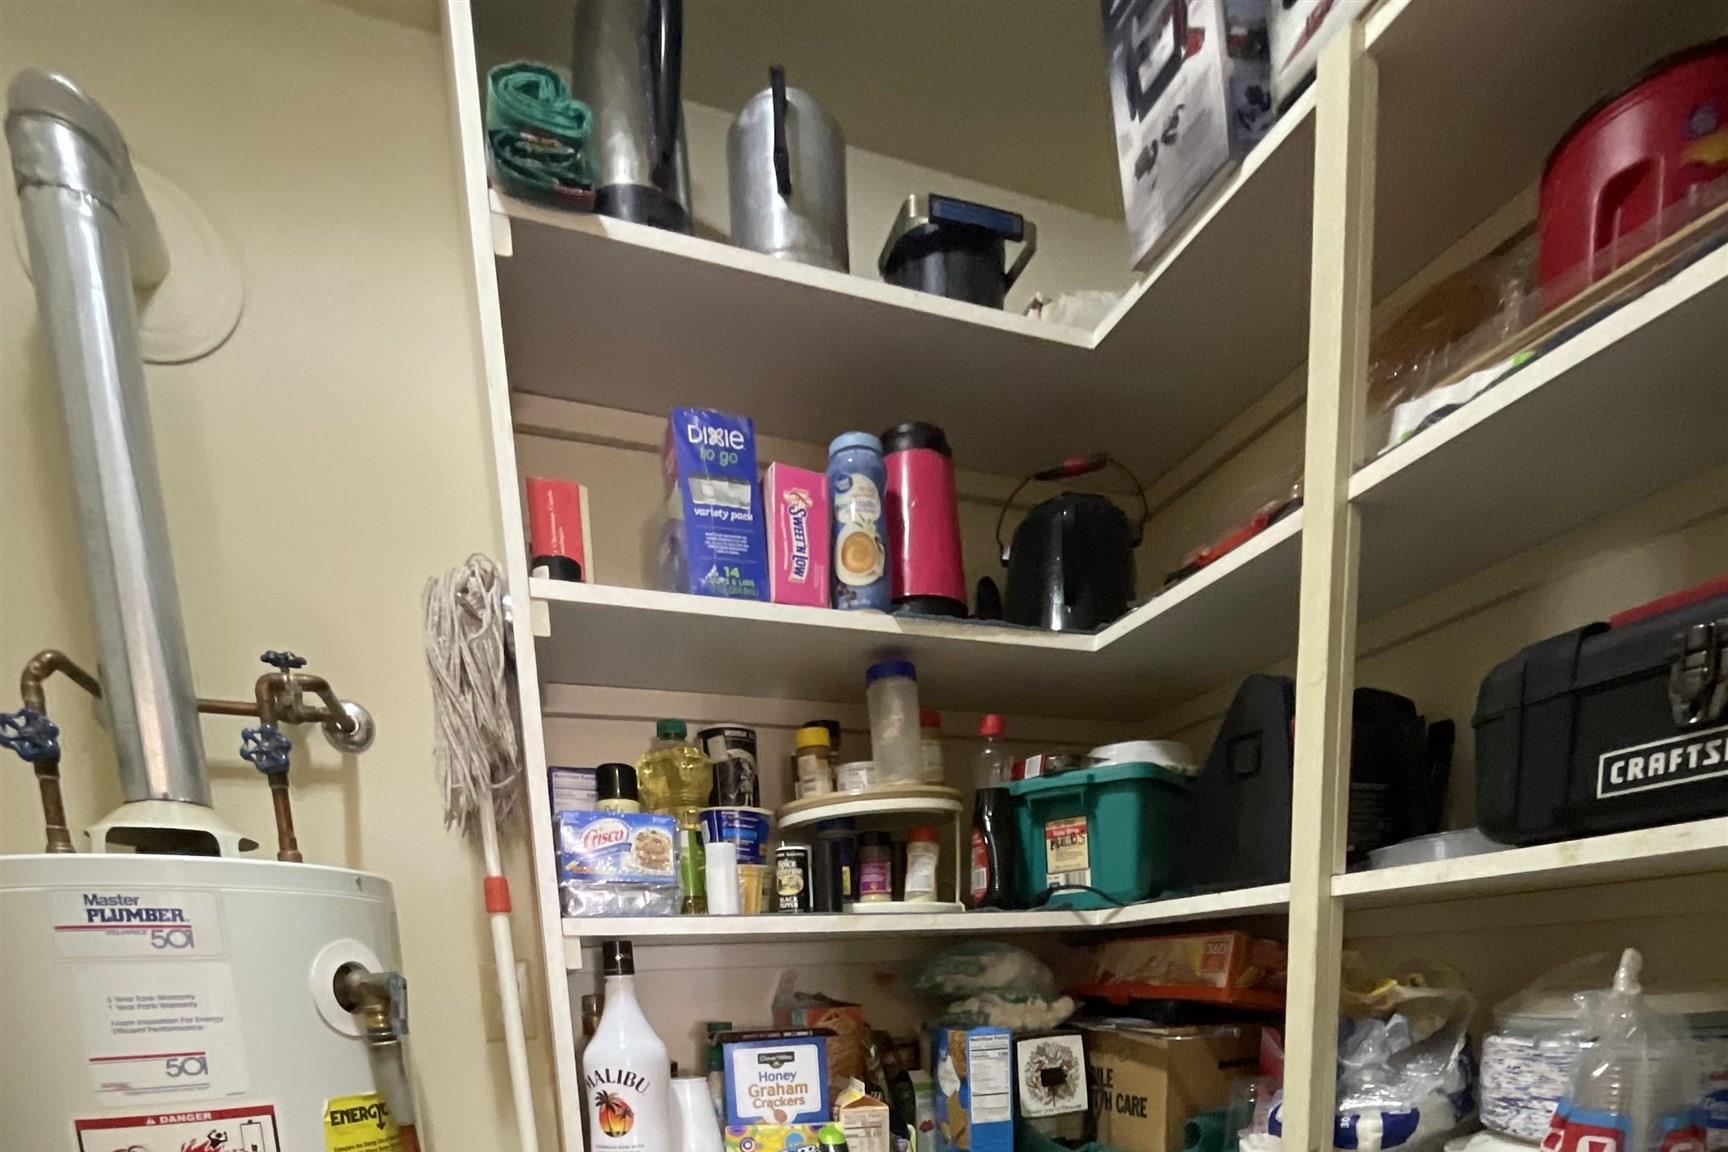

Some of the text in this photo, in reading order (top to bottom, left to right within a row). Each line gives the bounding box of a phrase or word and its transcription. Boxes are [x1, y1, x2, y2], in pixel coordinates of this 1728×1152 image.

[700, 445, 738, 467] to go
[693, 507, 754, 522] variety pack
[723, 566, 740, 578] 14
[83, 893, 140, 906] Master
[86, 908, 186, 923] PLUMBER
[151, 929, 195, 949] 501
[166, 1056, 209, 1078] 501
[586, 1068, 651, 1094] MALIBU
[758, 1071, 797, 1083] Honey
[748, 1083, 809, 1098] Graham
[752, 1096, 806, 1109] Crackers
[1116, 1092, 1148, 1118] CARE
[159, 1112, 212, 1124] DANGER
[330, 1102, 389, 1130] ENERGY
